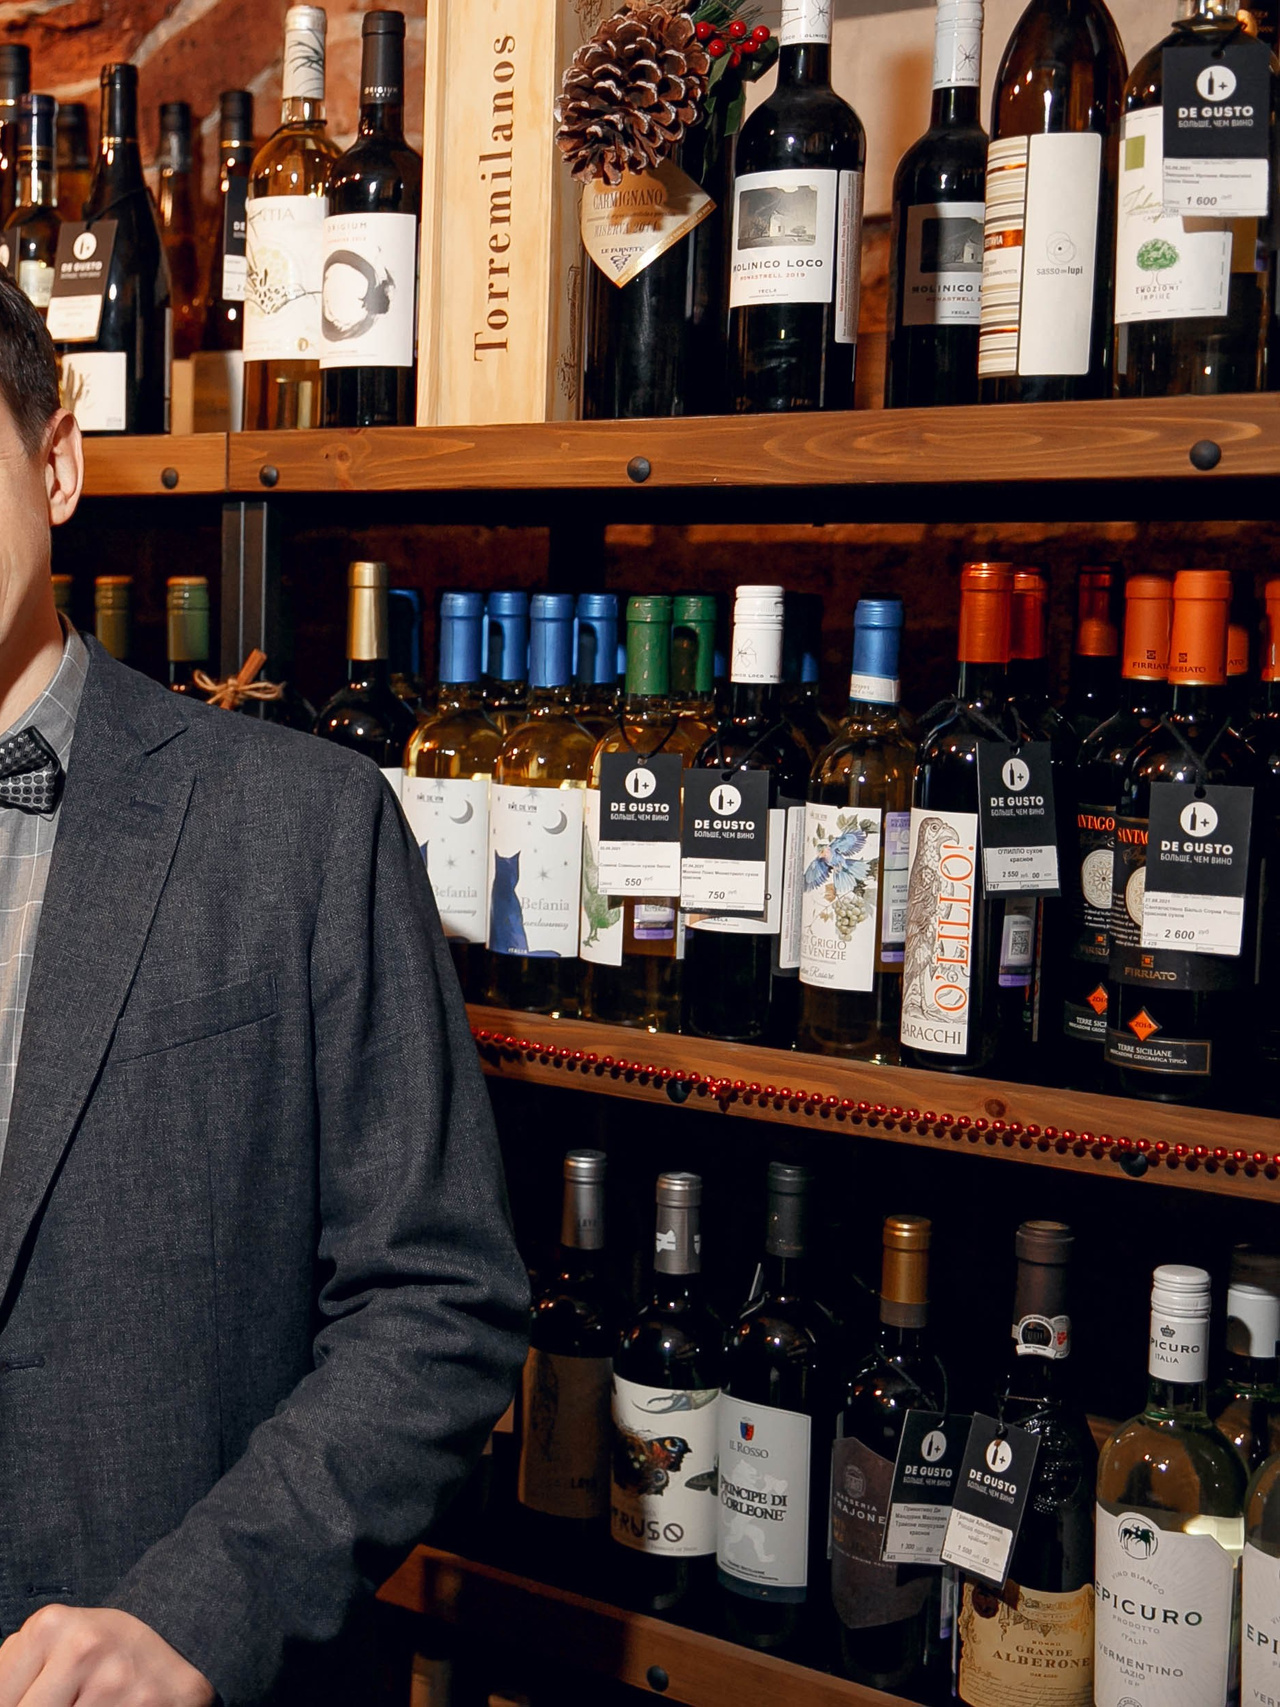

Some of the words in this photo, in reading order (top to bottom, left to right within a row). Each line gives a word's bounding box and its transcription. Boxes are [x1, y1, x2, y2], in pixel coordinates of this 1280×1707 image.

[1178, 107, 1198, 118] DE
[1202, 106, 1254, 118] GUSTO
[1231, 118, 1254, 127] ВИНО
[474, 35, 516, 362] Torremilanos
[594, 188, 662, 210] CARMIGNANO
[1186, 196, 1192, 205] 1
[1196, 196, 1218, 206] 600
[733, 260, 780, 273] MOLINICO
[787, 260, 824, 268] LOCO
[1036, 267, 1060, 276] sasso
[1067, 266, 1084, 277] lupi
[911, 284, 974, 294] MOLINICO
[1132, 662, 1168, 670] FIRRIAT
[610, 802, 626, 812] DE
[628, 803, 670, 812] GUSTO
[990, 797, 1004, 806] DE
[1007, 796, 1044, 806] GUSTO
[652, 814, 670, 822] ВИНО
[991, 808, 1016, 816] БОЛЬШЕ,
[1016, 808, 1028, 816] ЧЕМ
[694, 820, 710, 829] DE
[713, 820, 755, 830] GUSTO
[694, 830, 722, 838] БОЛЬШЕ,
[736, 832, 754, 840] ВИНО
[1026, 848, 1043, 856] сухое
[1161, 840, 1180, 852] DE
[1183, 842, 1234, 855] GUSTO
[1160, 853, 1192, 864] БОЛЬШЕ,
[1194, 855, 1210, 864] ЧЕМ
[1211, 857, 1232, 866] ВИНО
[624, 878, 642, 886] 550
[708, 891, 726, 900] 750
[521, 897, 570, 911] Befania
[934, 843, 975, 1012] O'LILLO!
[1164, 929, 1171, 938] 2
[1174, 930, 1195, 940] 600
[810, 936, 847, 950] GRIGIO
[808, 945, 846, 960] VENEZIE
[1124, 966, 1177, 980] FIRRIATO
[901, 1020, 962, 1045] BARACCHI
[1117, 1043, 1134, 1054] TERRE
[1136, 1046, 1172, 1058] SICILIANE
[1150, 1337, 1200, 1354] PICURO
[1155, 1353, 1180, 1364] ITALIA
[729, 1440, 736, 1450] IL
[736, 1441, 769, 1458] ROSSO
[904, 1464, 918, 1476] DE
[920, 1466, 952, 1478] GUSTO
[969, 1468, 982, 1481] DE
[984, 1474, 1017, 1494] GUSTO
[720, 1474, 767, 1504] PRINCIPE
[771, 1494, 788, 1506] DI
[722, 1492, 786, 1522] CORLEONE
[836, 1492, 878, 1512] MASSERIA
[1130, 1572, 1165, 1596] BIANCO
[1094, 1580, 1202, 1626] EPICURO
[1112, 1614, 1160, 1634] PRODOTTO
[1121, 1632, 1148, 1646] ITALIA
[1016, 1645, 1072, 1657] GRANDE
[992, 1650, 1091, 1669] ALBERONE
[1098, 1641, 1184, 1678] VERMENTINO
[1120, 1666, 1146, 1680] LAZIO
